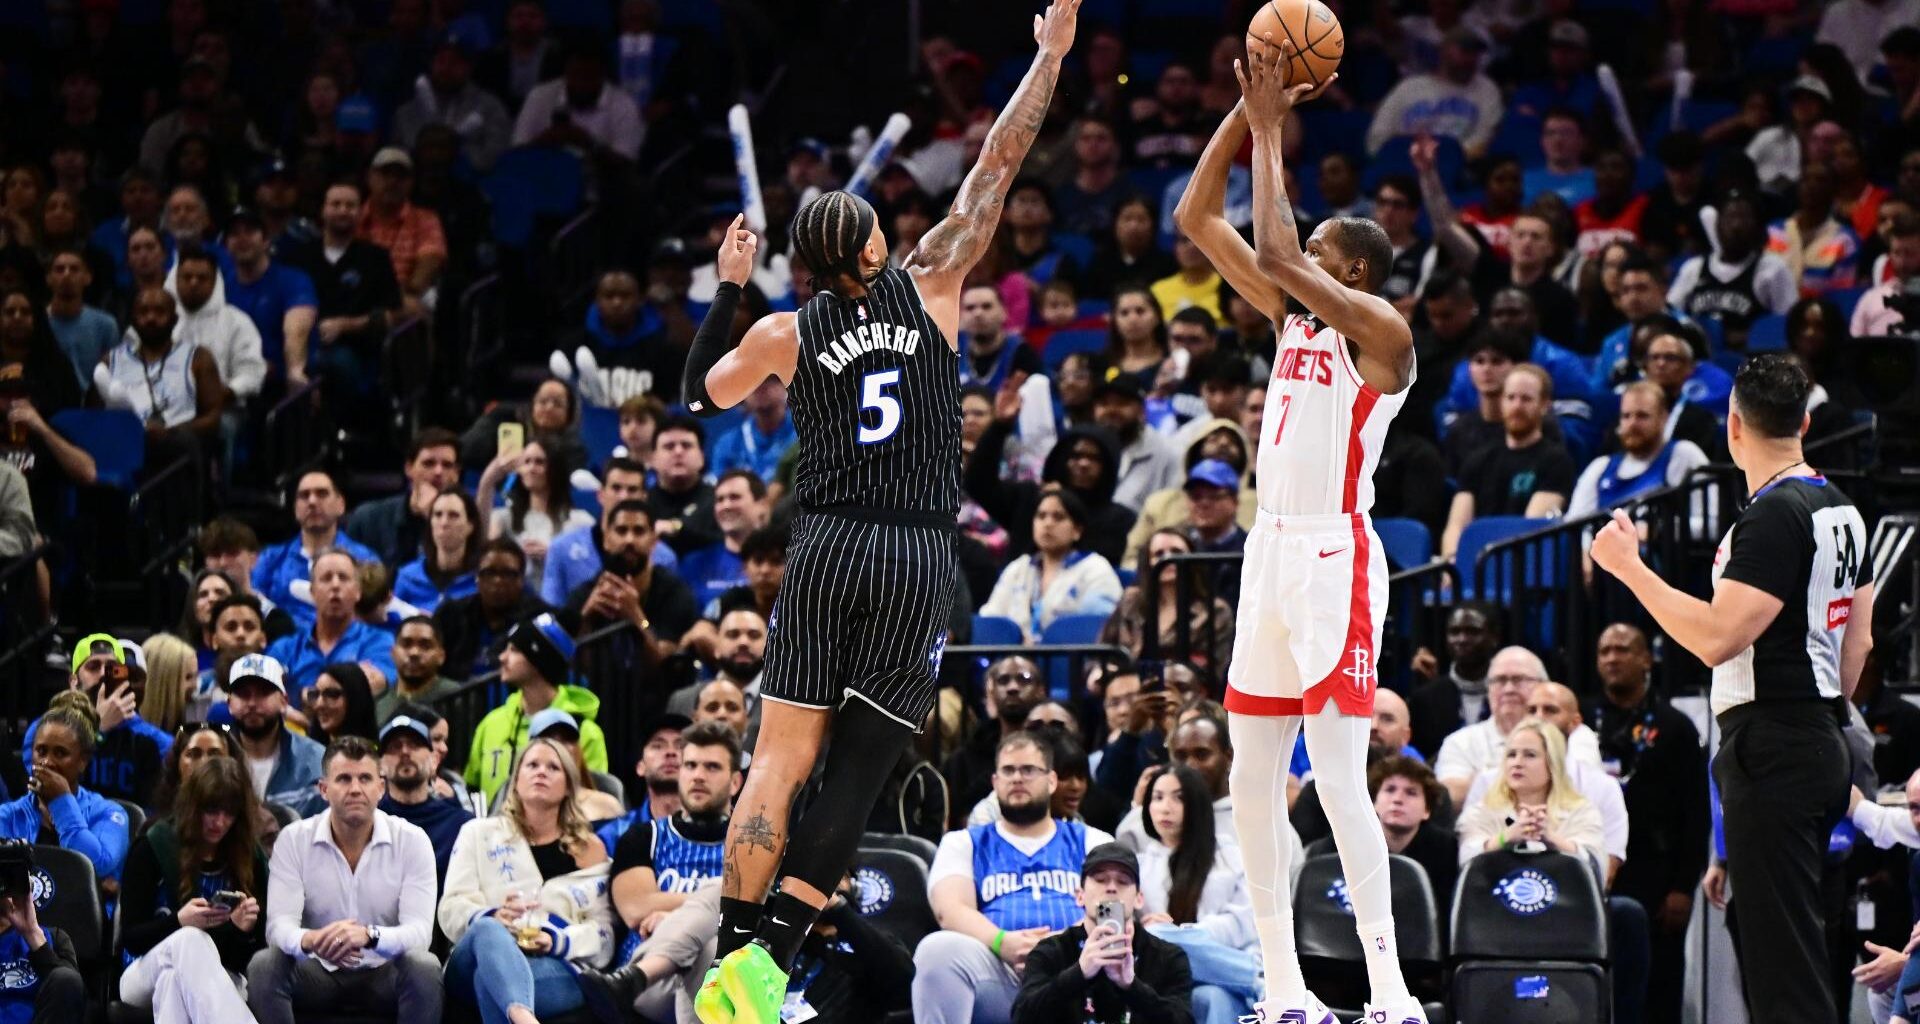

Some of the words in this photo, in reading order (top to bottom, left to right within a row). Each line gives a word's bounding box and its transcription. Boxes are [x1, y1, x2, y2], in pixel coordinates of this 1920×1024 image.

[817, 322, 920, 376] BANCHERO
[858, 369, 902, 445] 5
[1274, 395, 1292, 446] 7
[1832, 524, 1858, 590] 54
[981, 869, 1081, 903] ORLANDO
